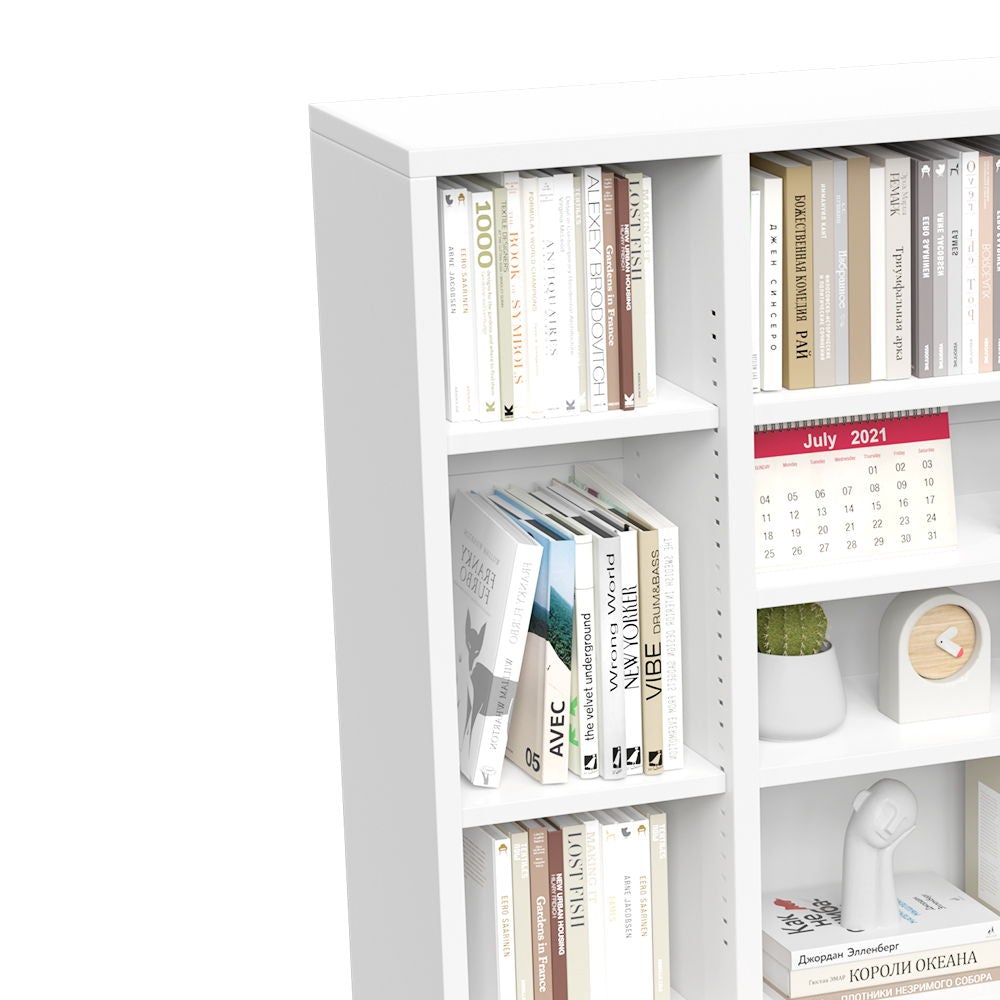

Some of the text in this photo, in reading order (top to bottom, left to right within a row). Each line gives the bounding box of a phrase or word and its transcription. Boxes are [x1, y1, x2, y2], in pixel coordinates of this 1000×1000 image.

[475, 201, 493, 269] 1000
[629, 181, 642, 280] LOST FISH
[587, 174, 605, 396] ALEXEY BRODOVITCH
[606, 245, 615, 292] Gardens
[794, 194, 812, 359] БОЖЕСТВЕННАЯ КОМЕДИЯ РАЙ
[608, 294, 615, 306] in
[892, 246, 905, 360] Триумфальная арка
[803, 427, 887, 450] July 2021
[869, 460, 932, 474] 01 02 03
[760, 478, 934, 504] 04 05 06 07 08 09 10
[762, 514, 770, 522] 11
[790, 511, 799, 519] 12
[818, 507, 826, 516] 13
[872, 501, 881, 510] 15
[899, 498, 908, 507] 16
[926, 495, 934, 504] 17
[764, 532, 773, 540] 18
[818, 526, 828, 534] 20
[846, 523, 854, 531] 21
[873, 519, 882, 528] 22
[900, 516, 909, 525] 23
[927, 513, 936, 522] 24
[765, 531, 936, 558] 25 26 27 28 29 30 31
[606, 554, 618, 692] Wrong World
[621, 585, 639, 689] NEW YORKER
[645, 549, 662, 700] VIBE DRUM&BASS
[581, 613, 594, 741] the velvet underground
[549, 700, 565, 757] AVEC
[525, 747, 540, 772] 05
[568, 832, 584, 927] LOST FISH
[624, 898, 632, 939] JACOBSEN
[777, 913, 815, 936] Как
[803, 909, 833, 928] не
[797, 942, 900, 967] Джордан Элленберг
[849, 951, 978, 983] КОРОЛИ ОКЕАНА
[895, 980, 953, 995] НЕЗРИМОГО
[955, 972, 992, 988] СОБОРА
